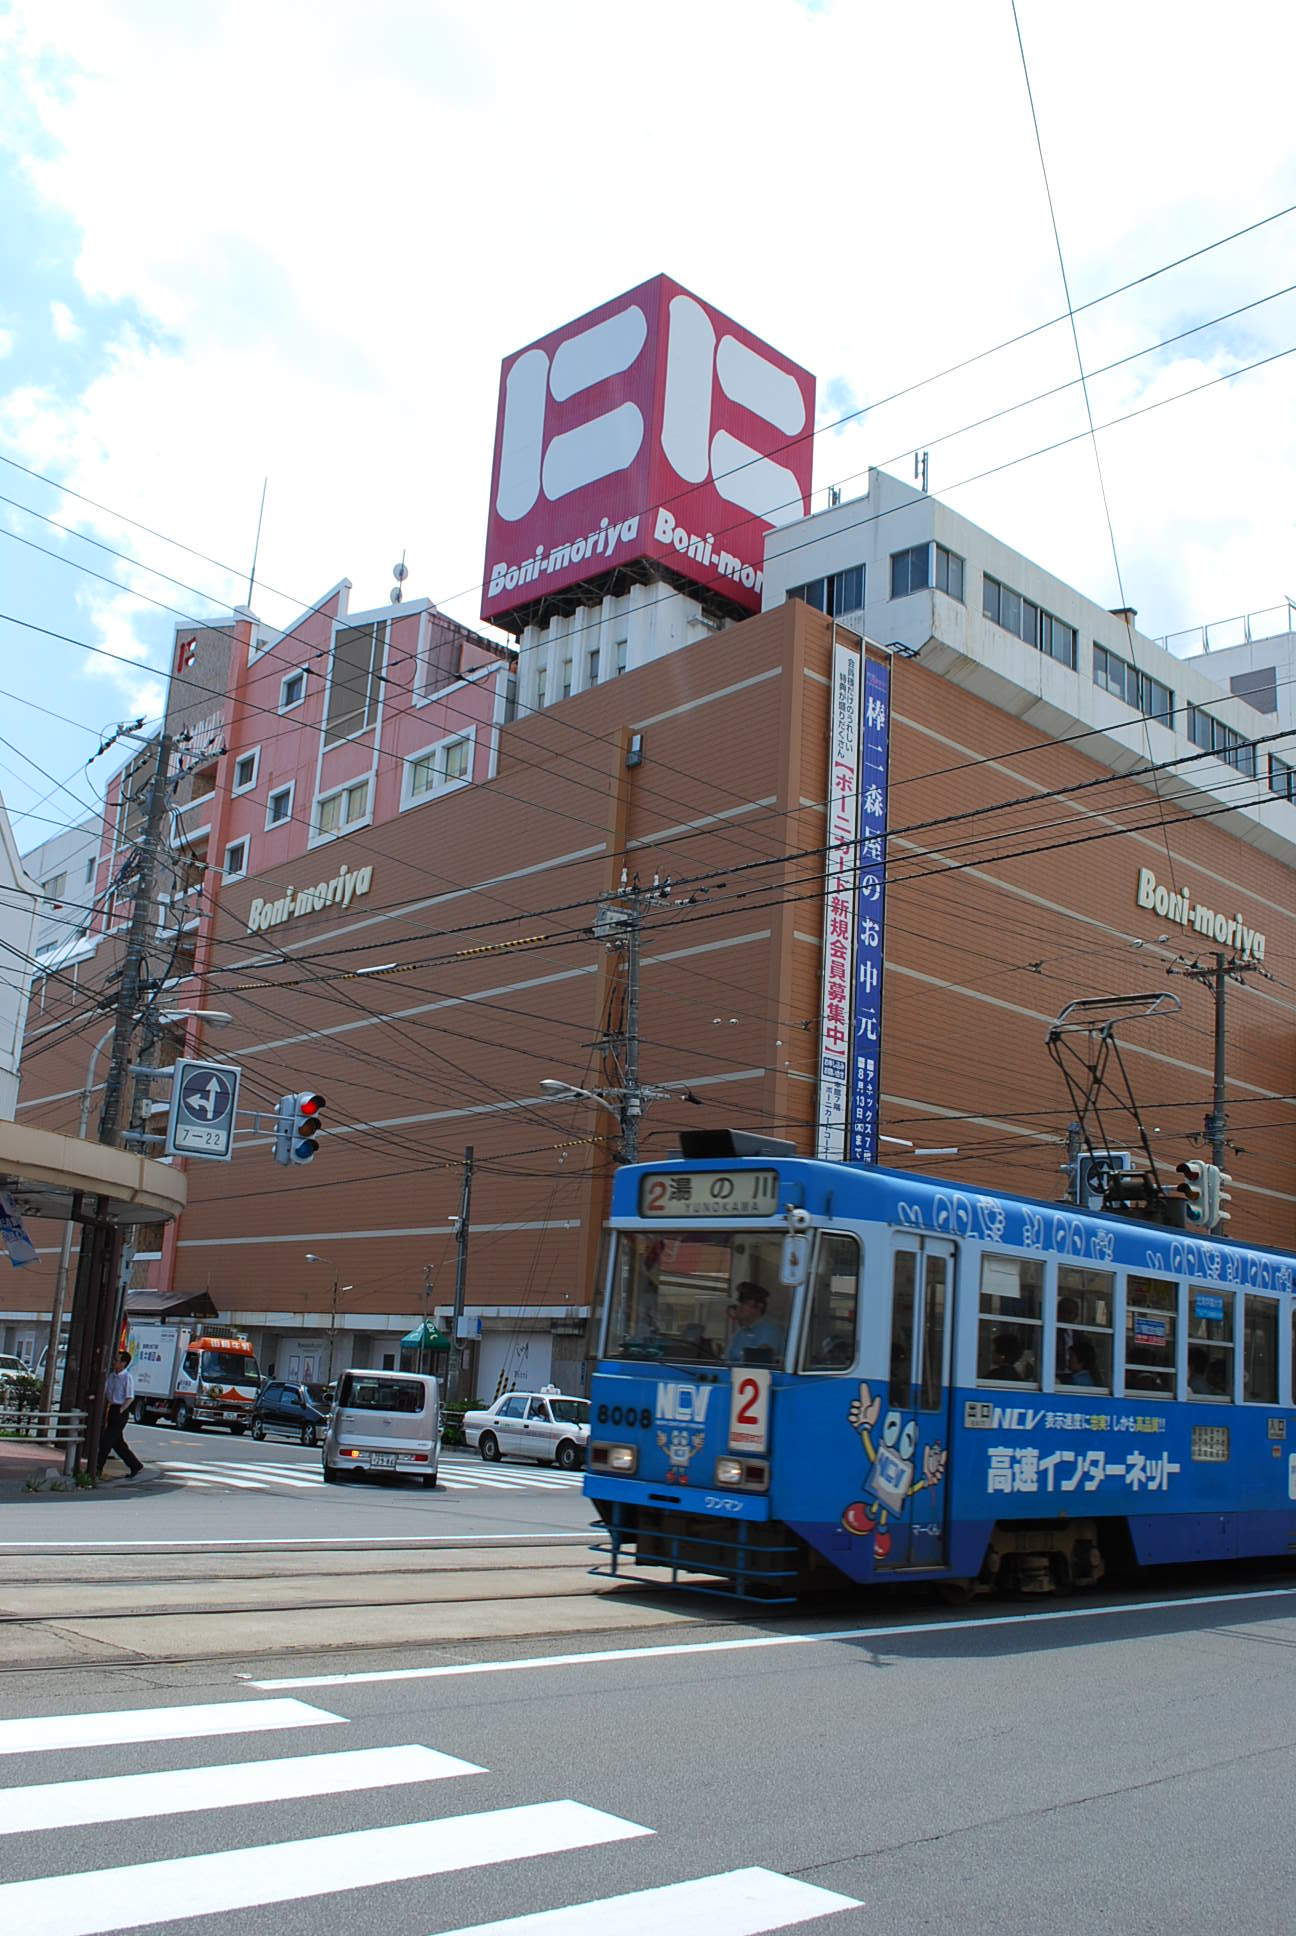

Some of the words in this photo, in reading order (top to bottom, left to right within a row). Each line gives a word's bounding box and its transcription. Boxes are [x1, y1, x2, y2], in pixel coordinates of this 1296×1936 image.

[488, 515, 640, 598] Boni-moriya
[248, 864, 373, 934] Boni-moriya
[1137, 867, 1265, 961] Boni-moriya
[647, 1181, 667, 1211] 2
[685, 1202, 759, 1213] YUNOKAWA
[597, 1404, 652, 1429] 8008
[737, 1378, 760, 1425] 2
[993, 1407, 1045, 1430] NCV
[987, 1446, 1181, 1493] 高速インターネット
